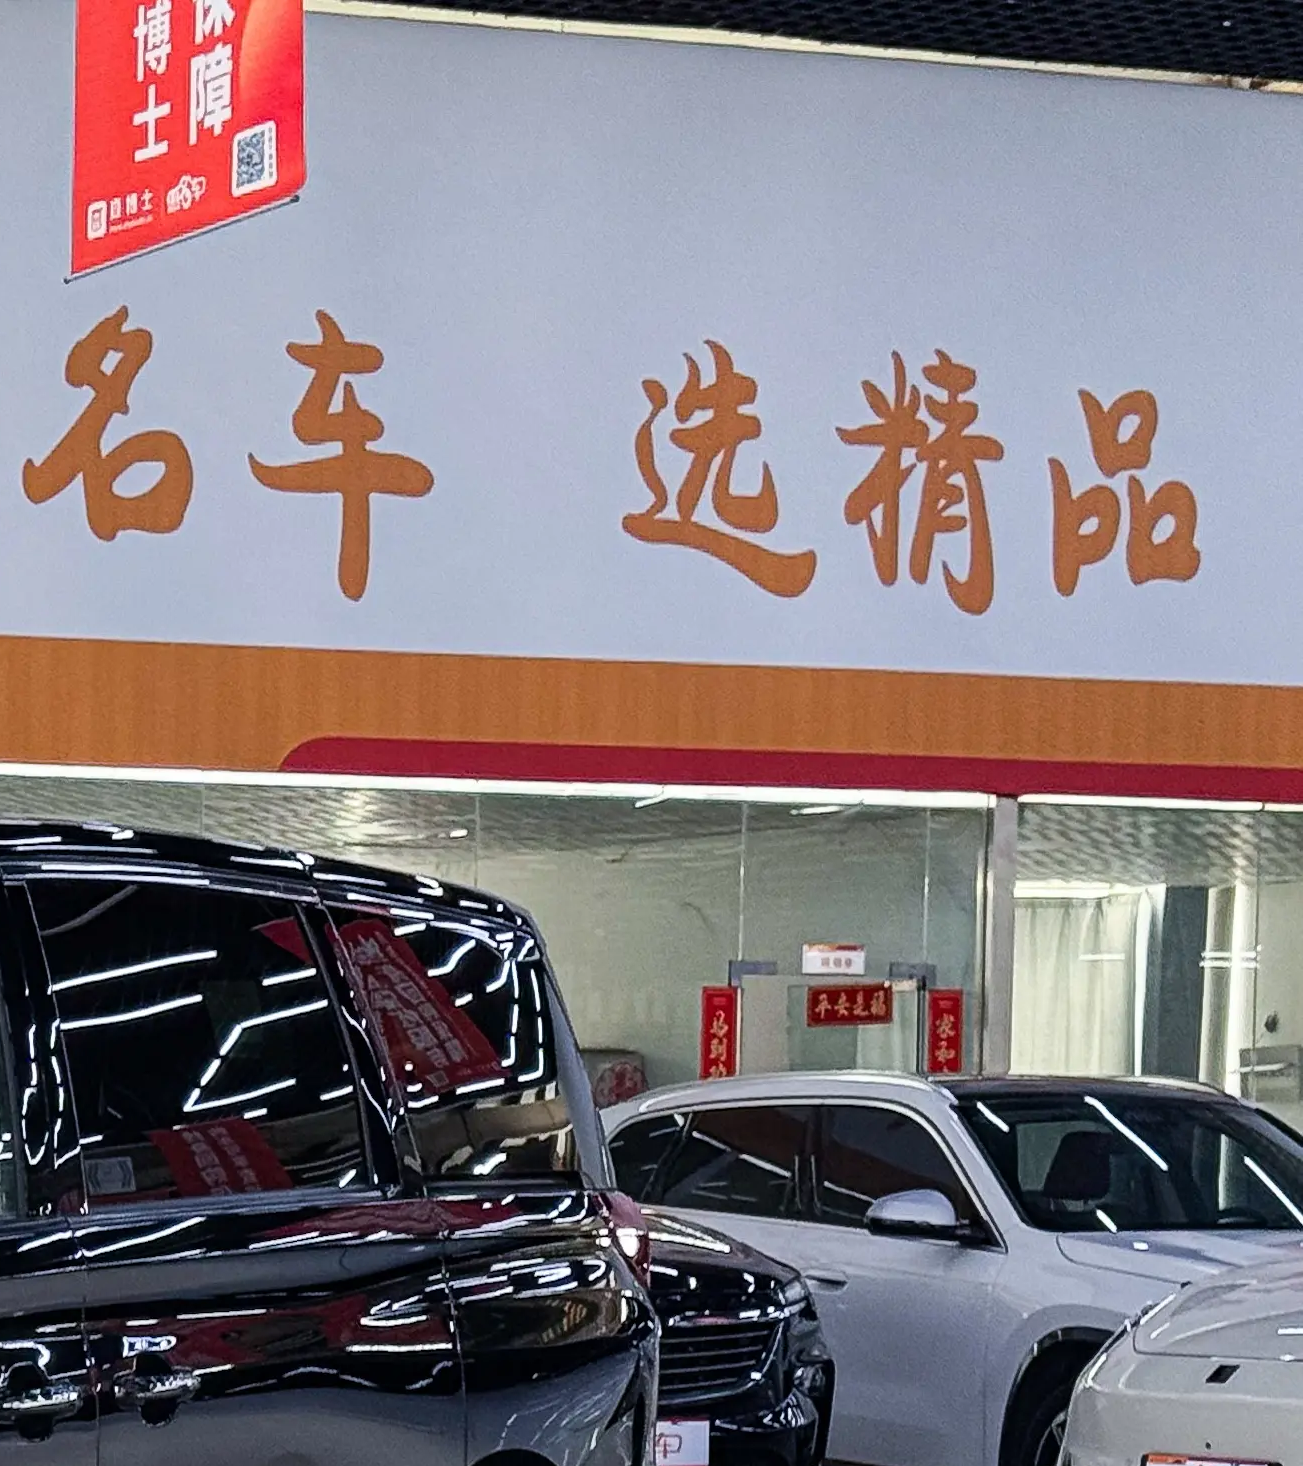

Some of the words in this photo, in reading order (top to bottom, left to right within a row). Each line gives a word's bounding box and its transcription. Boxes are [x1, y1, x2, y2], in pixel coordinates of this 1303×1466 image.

[623, 339, 1201, 615] 选精品
[814, 990, 886, 1019] 平安是福
[934, 1012, 956, 1073] 家和
